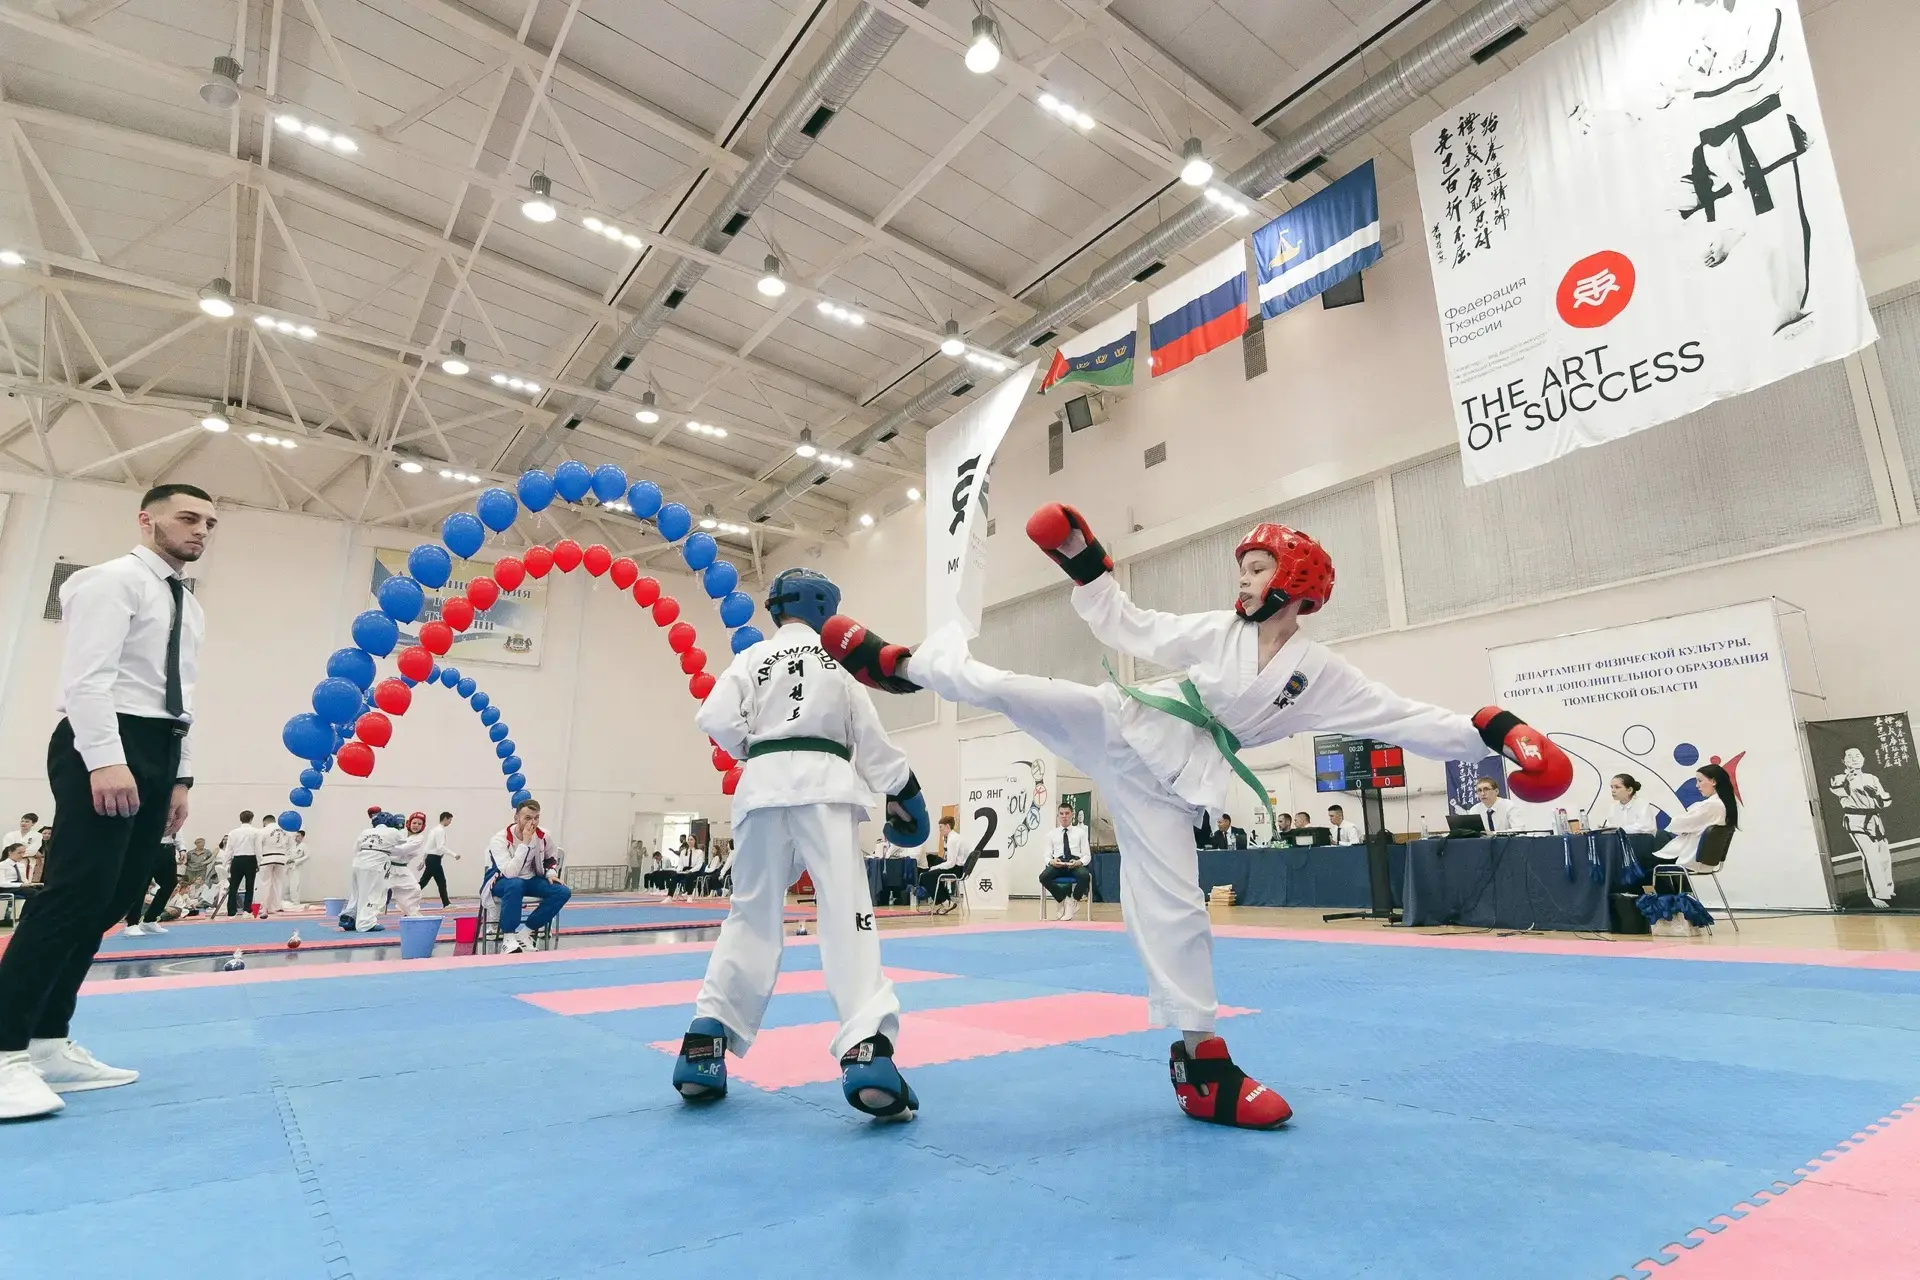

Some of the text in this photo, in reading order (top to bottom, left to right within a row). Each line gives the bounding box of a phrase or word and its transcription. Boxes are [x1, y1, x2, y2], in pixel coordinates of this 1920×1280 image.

[1444, 277, 1527, 319] Федерация
[1446, 296, 1522, 333] Тхэквондо
[1448, 320, 1503, 348] России
[1461, 378, 1528, 424] THE
[1541, 344, 1608, 397] ART
[1467, 412, 1512, 451] OF
[1523, 341, 1705, 431] SUCCESS
[757, 645, 837, 686] TAEKWON-DO
[1503, 652, 1769, 699] СПОРТА И ДОПОЛНИТЕЛЬНОГО ОБРАЗОВАНИЯ
[1514, 637, 1751, 683] ДЕПАРТАМЕНТ ФИЗИЧЕСКОЙ КУЛЬТУРЫ,
[1562, 680, 1698, 707] ТЮМЕНСКОЙ ОБЛАСТИ
[968, 788, 1004, 802] ДО ЯНГ
[1355, 779, 1362, 788] 0
[1384, 777, 1391, 786] 0
[974, 806, 1000, 859] 2
